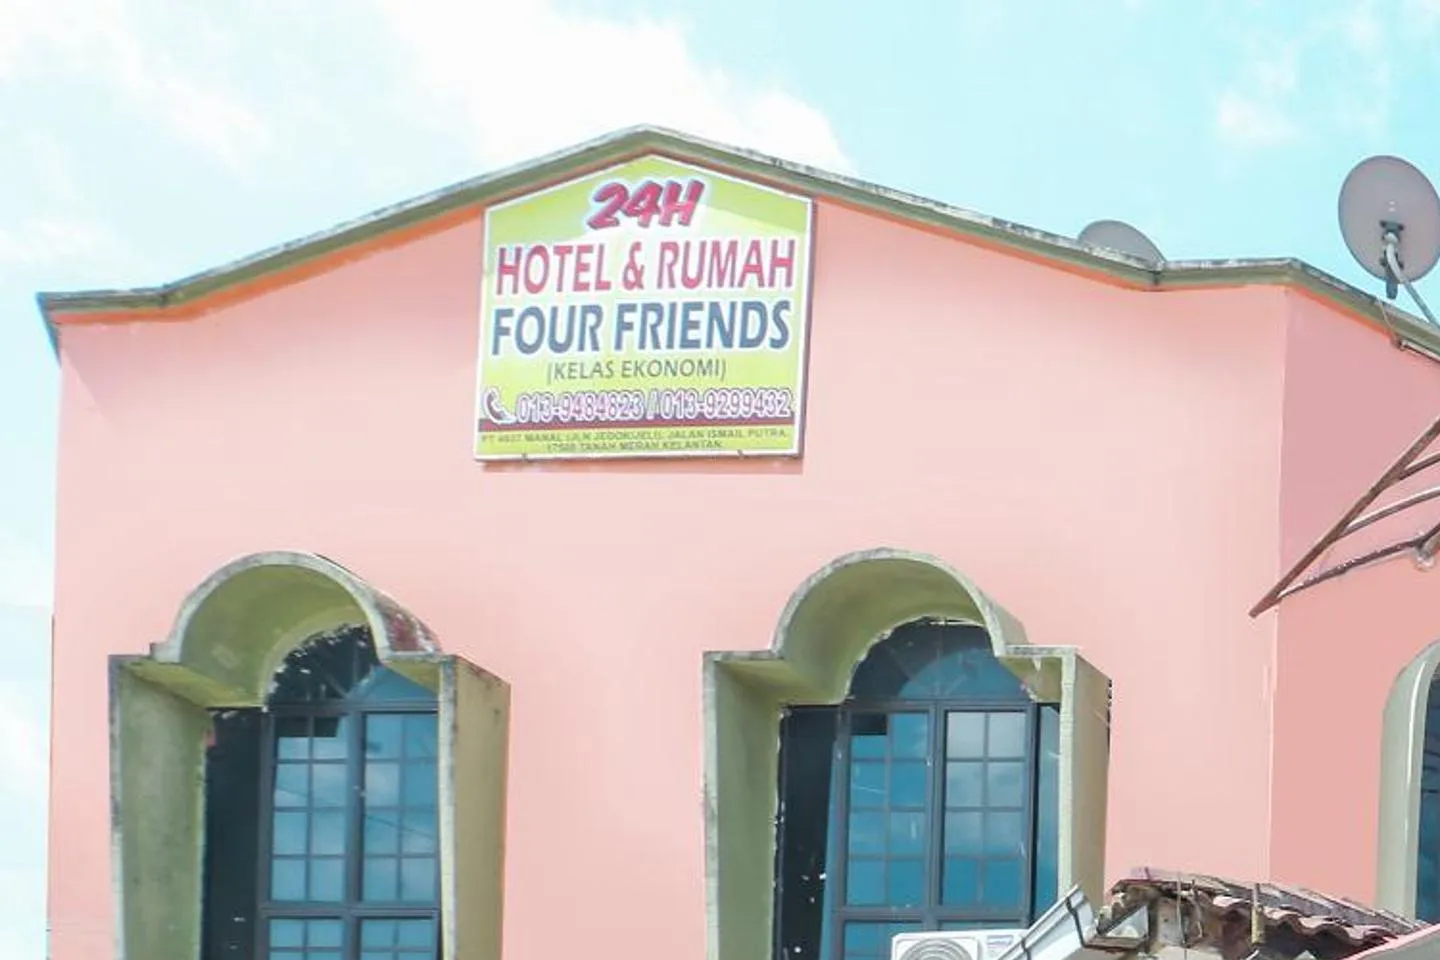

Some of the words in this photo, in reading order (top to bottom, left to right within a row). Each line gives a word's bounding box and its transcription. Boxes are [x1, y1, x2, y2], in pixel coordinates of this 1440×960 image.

[587, 179, 705, 231] 24H
[496, 243, 612, 296] HOTEL
[621, 241, 646, 291] &
[656, 239, 796, 289] RUMAH
[491, 304, 604, 356] FOUR
[613, 300, 791, 351] FRIENDS
[546, 359, 615, 385] (KELAS
[621, 357, 727, 384] EKONOMI)
[516, 389, 645, 423] 013-9484823
[660, 387, 792, 420] 013-9299432
